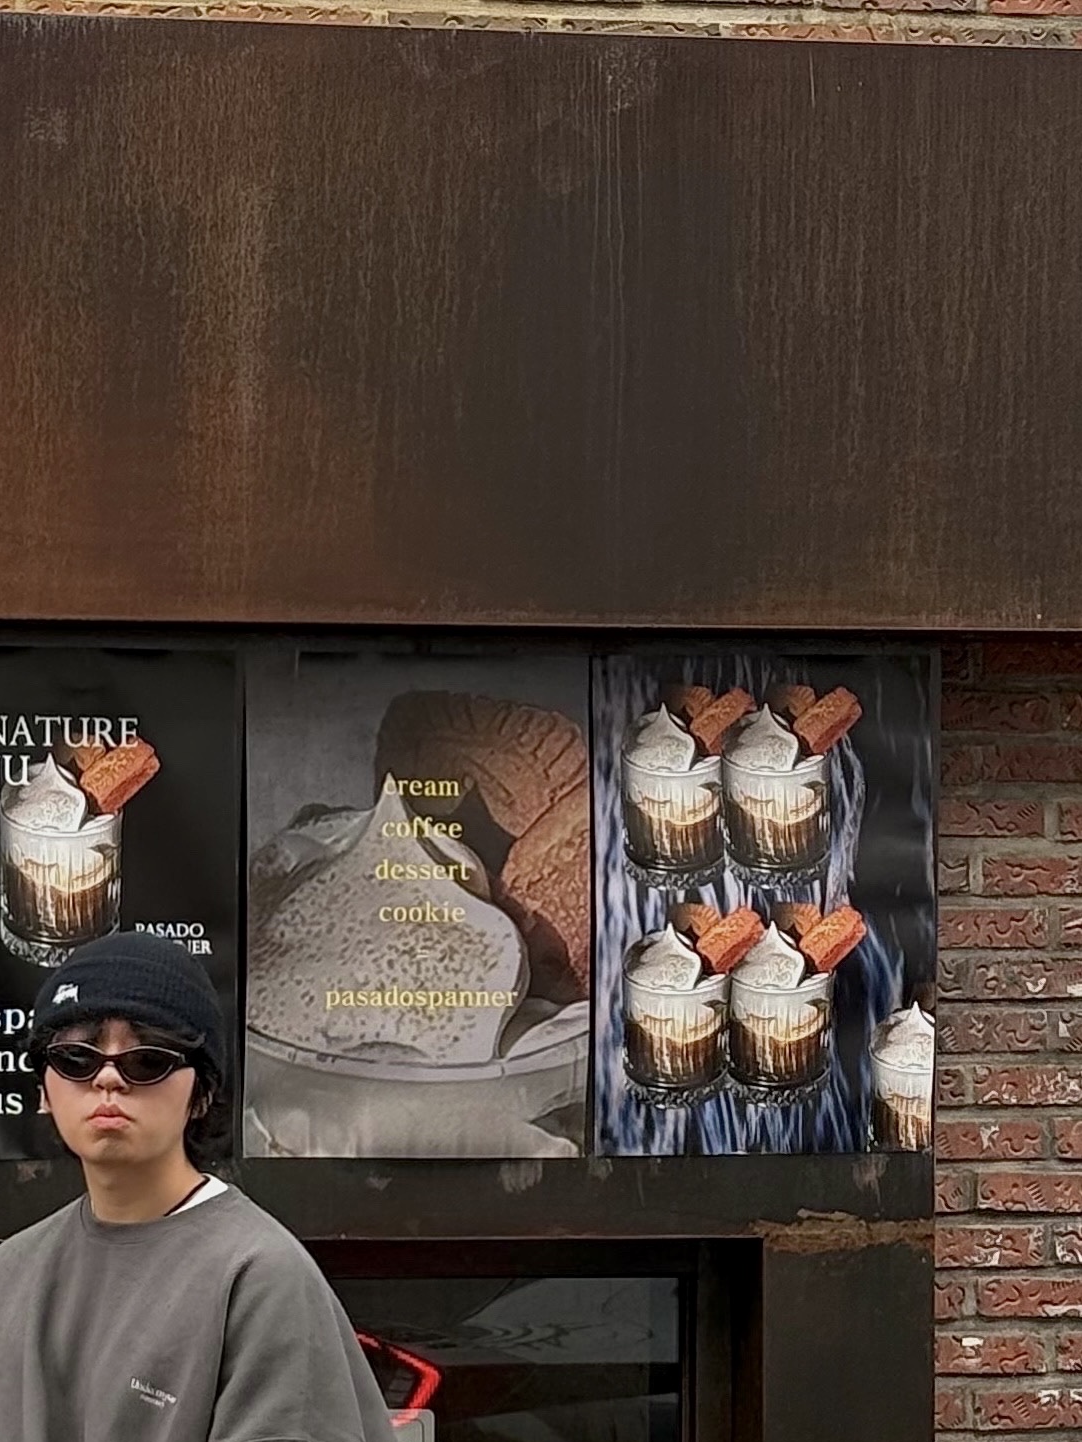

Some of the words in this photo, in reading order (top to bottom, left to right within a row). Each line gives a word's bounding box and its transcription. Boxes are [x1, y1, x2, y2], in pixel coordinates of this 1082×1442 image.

[384, 777, 460, 797] cream
[381, 815, 464, 839] coffee
[374, 858, 471, 881] dessert
[378, 901, 467, 923] cookie
[135, 922, 205, 938] PASADO
[326, 985, 518, 1010] pasadospanner
